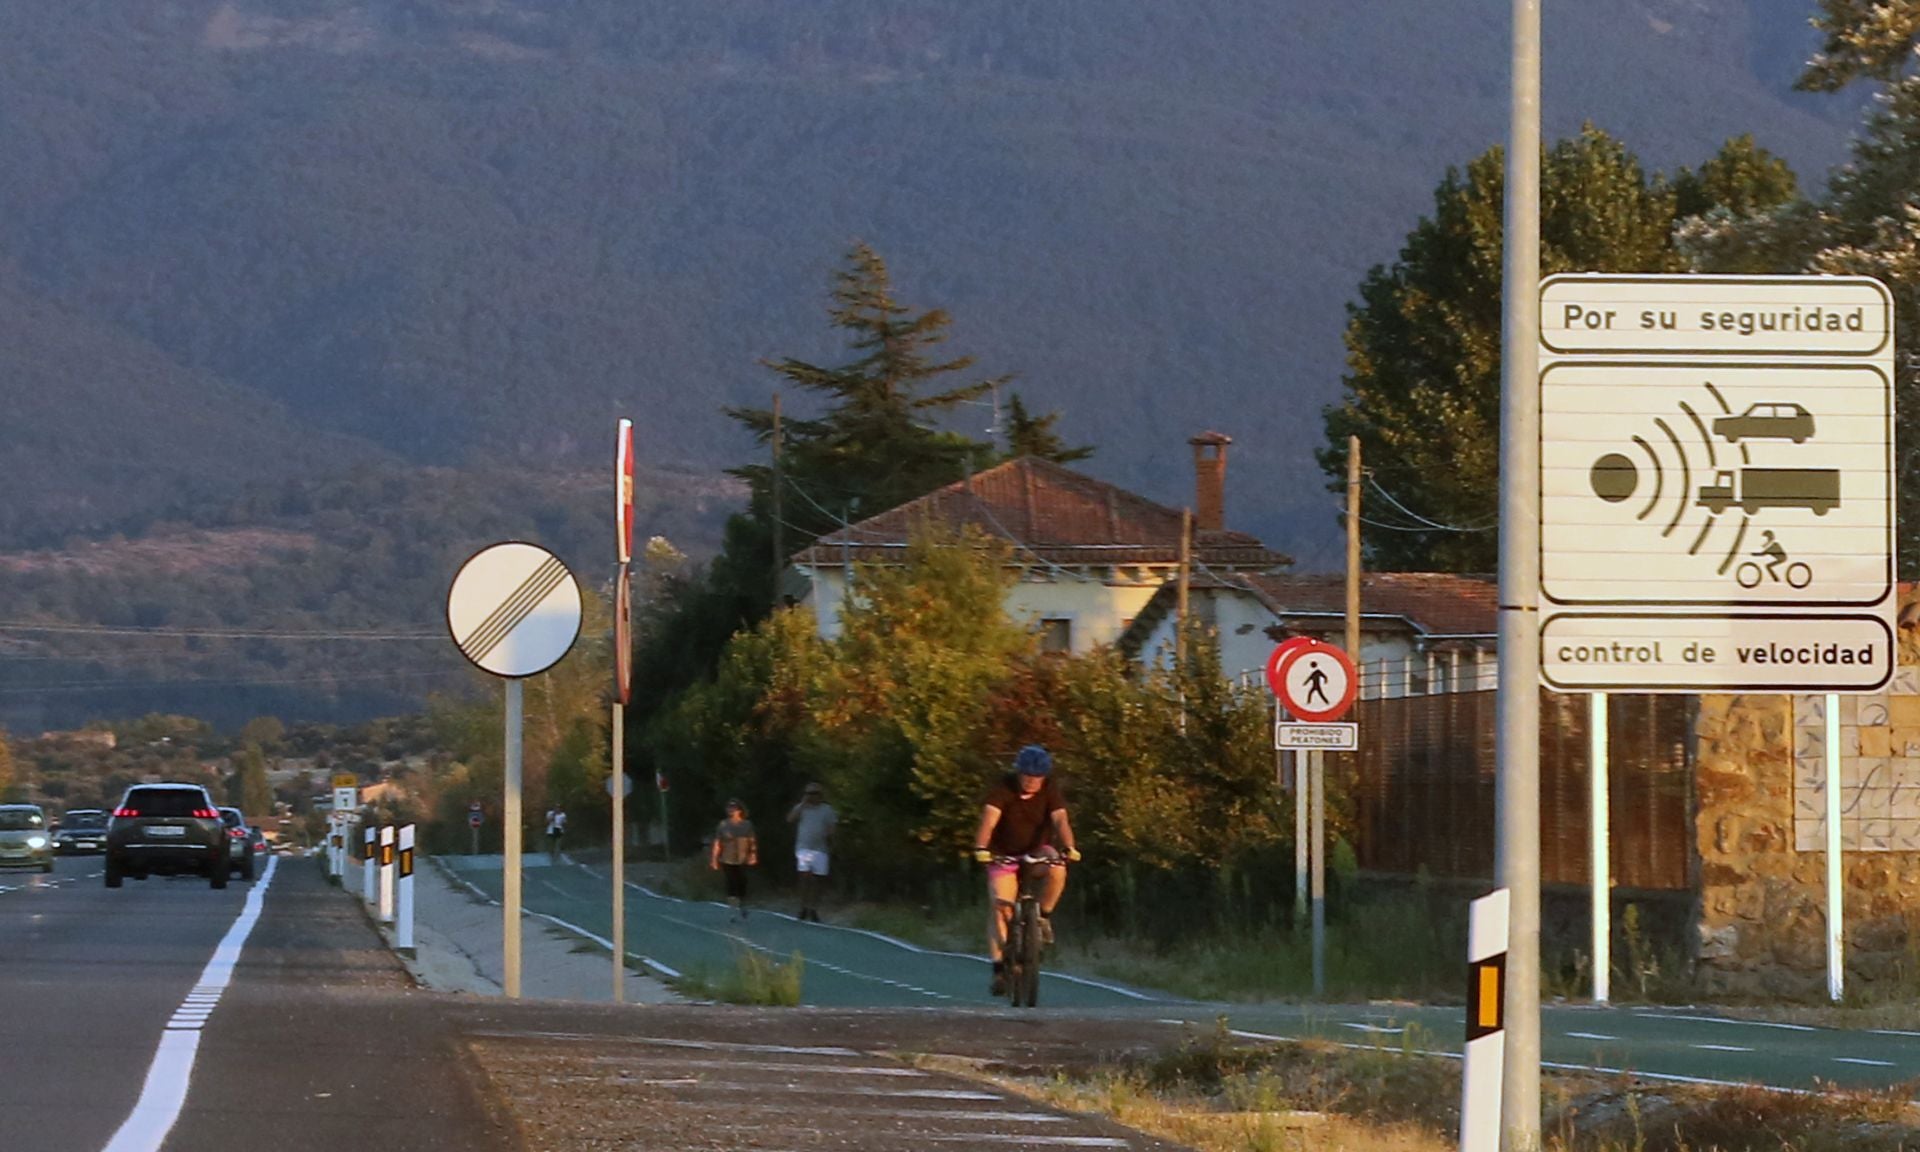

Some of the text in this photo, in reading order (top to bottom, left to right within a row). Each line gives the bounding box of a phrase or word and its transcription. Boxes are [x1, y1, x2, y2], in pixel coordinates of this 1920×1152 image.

[1564, 304, 1864, 335] Por su seguridad
[1558, 641, 1874, 665] control de velocidad
[1290, 728, 1343, 736] PROHIBIDO
[1291, 736, 1342, 744] PEATONES
